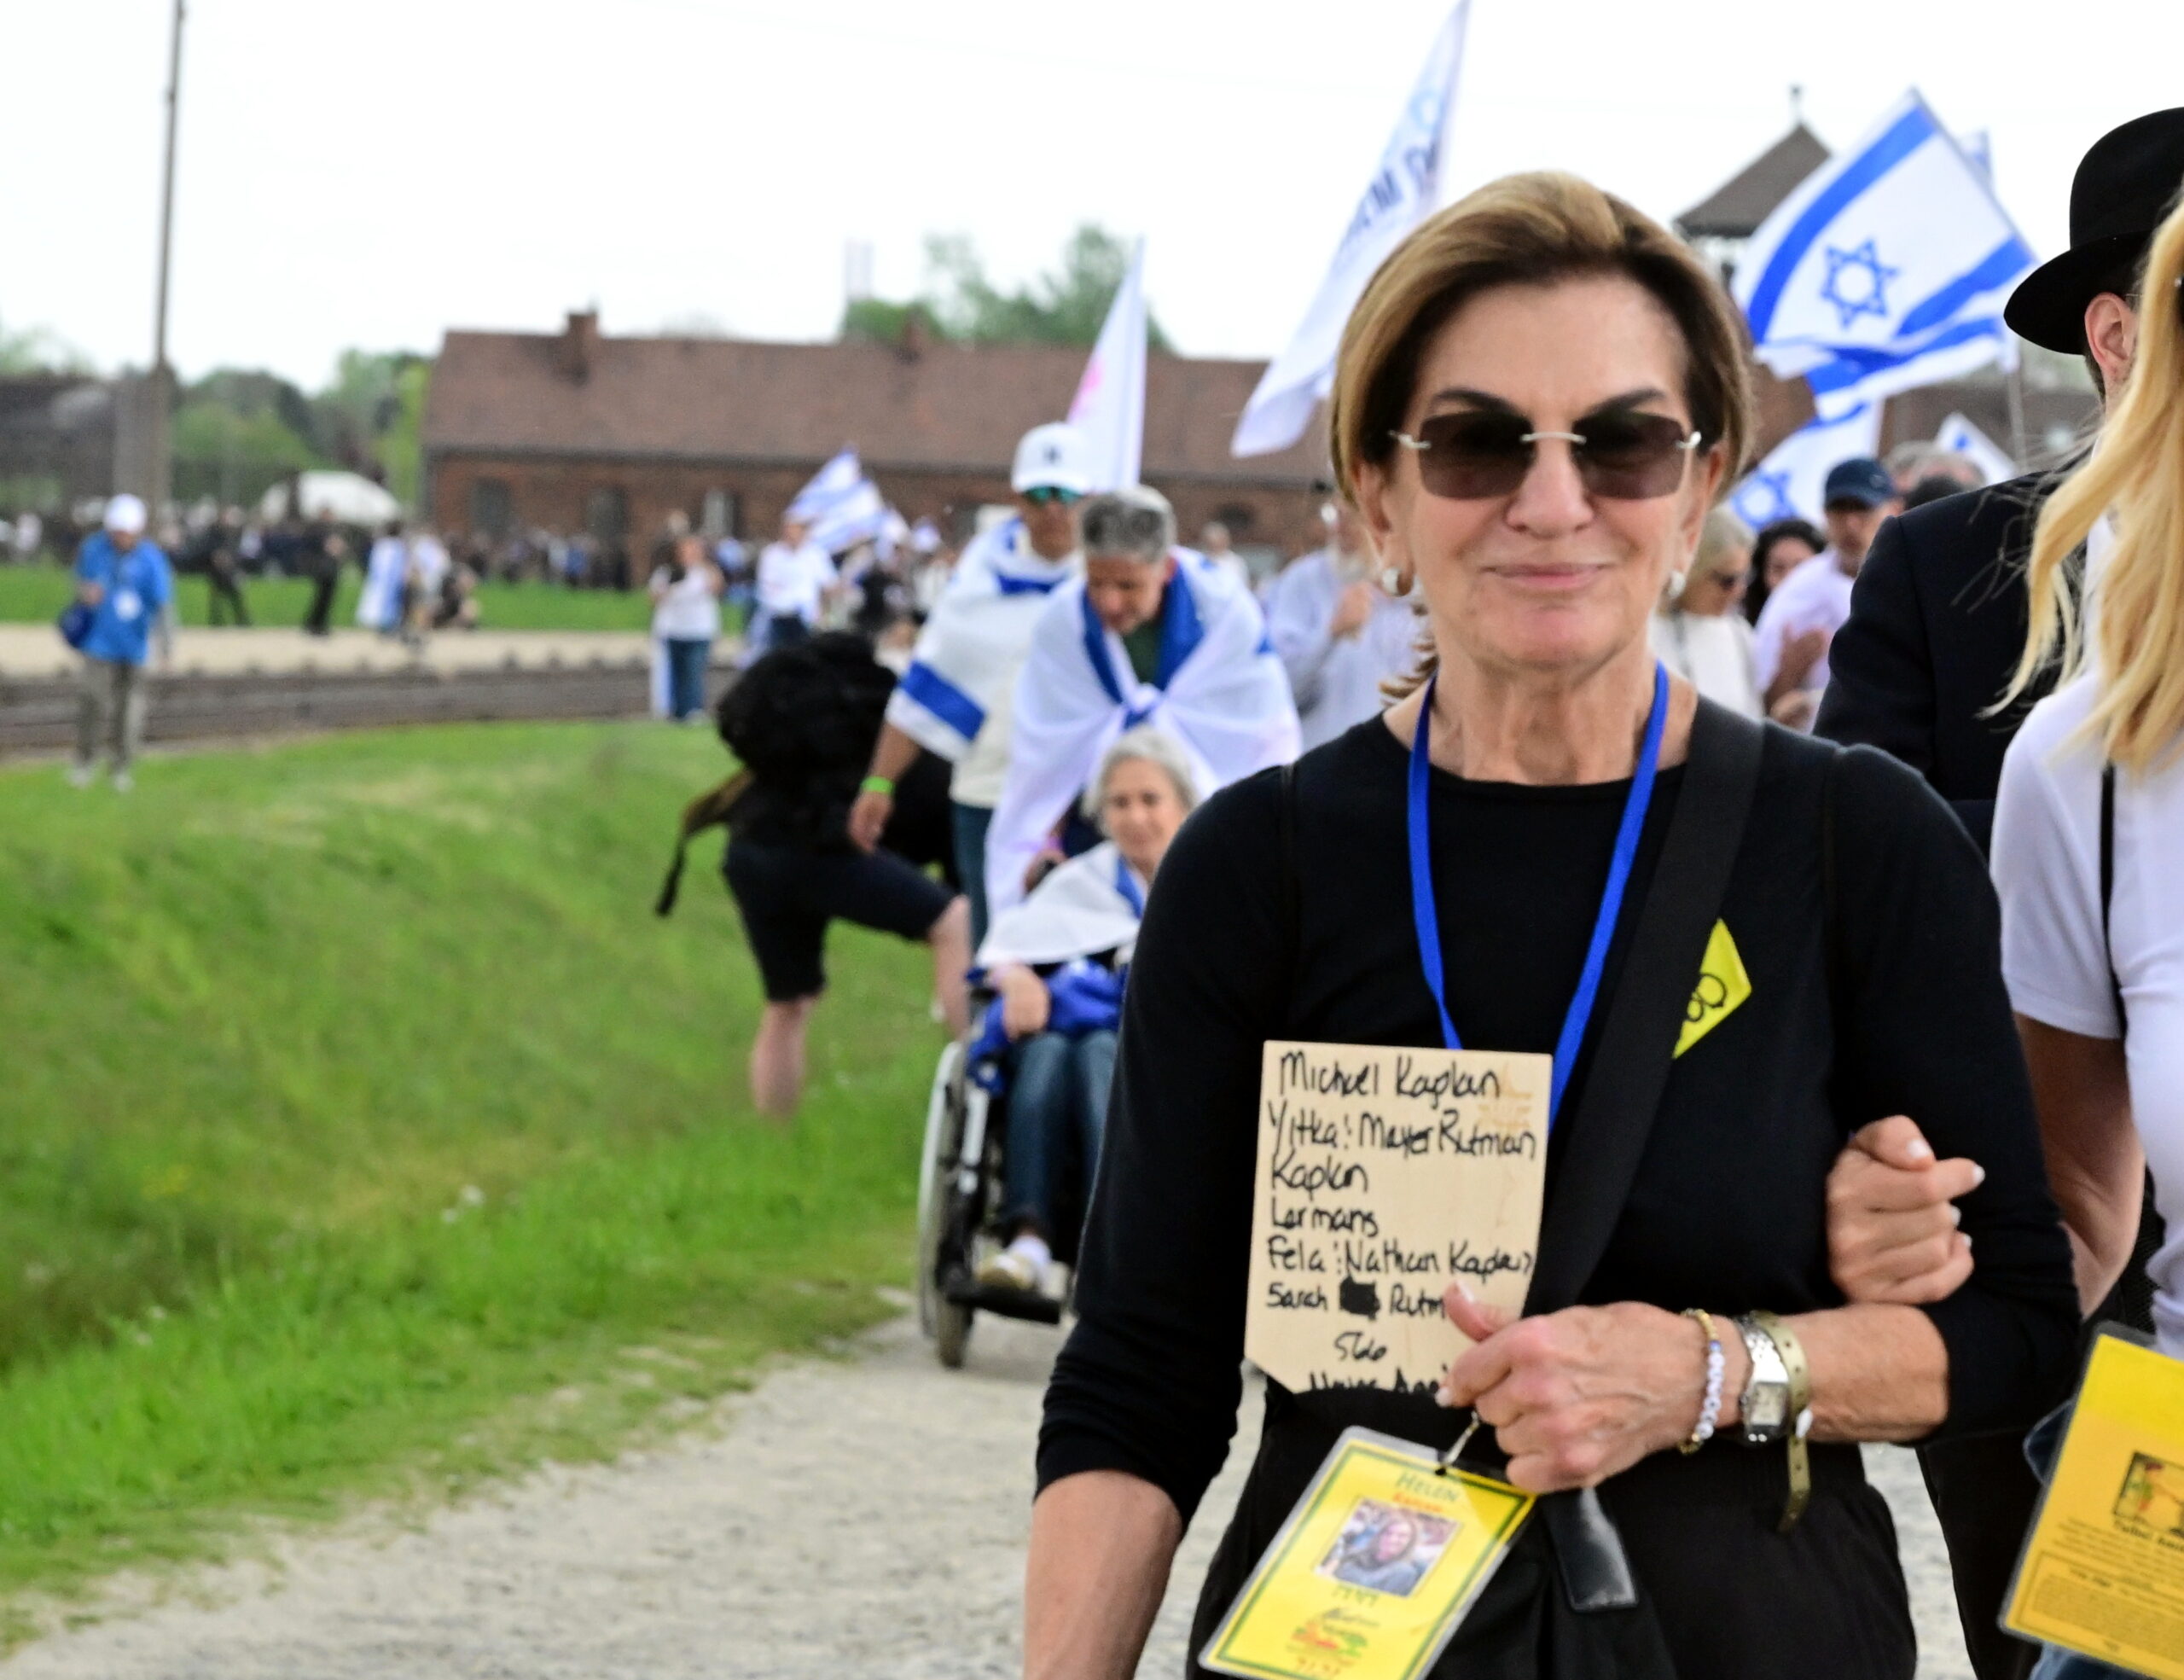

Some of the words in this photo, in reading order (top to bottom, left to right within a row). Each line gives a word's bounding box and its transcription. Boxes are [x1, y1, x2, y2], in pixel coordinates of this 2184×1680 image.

[1396, 1052, 1501, 1110] Kaplan
[1268, 1235, 1326, 1270] Fela
[1266, 1282, 1328, 1312] Sarah
[1390, 1282, 1446, 1320] Rutm
